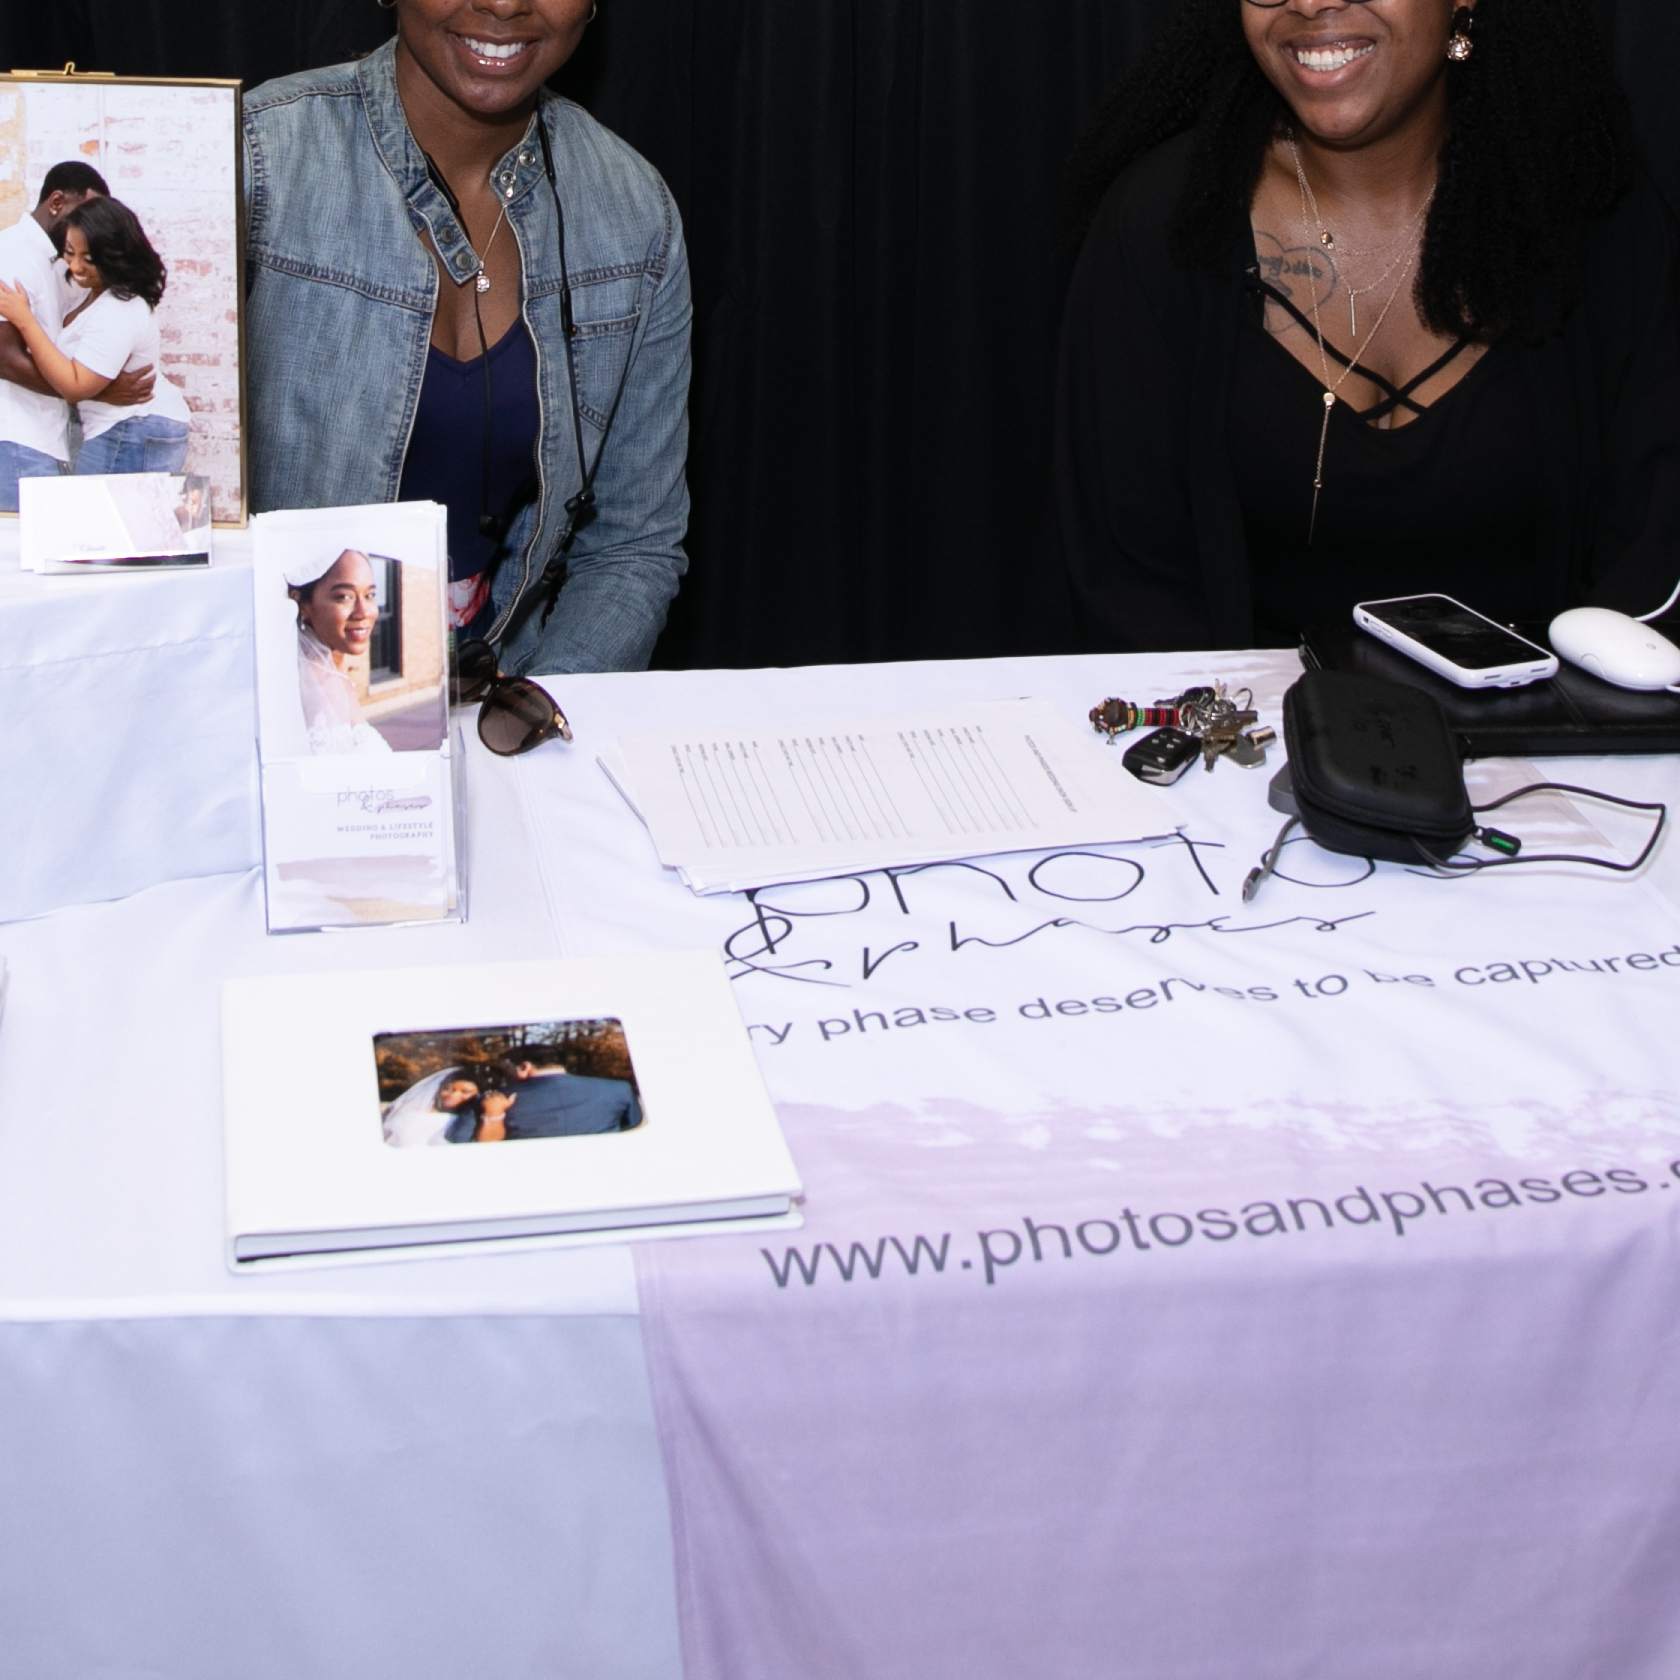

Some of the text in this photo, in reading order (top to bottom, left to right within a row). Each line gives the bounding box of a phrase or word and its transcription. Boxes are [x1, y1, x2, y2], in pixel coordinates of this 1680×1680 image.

[337, 784, 394, 807] photos
[337, 824, 378, 833] WEDDING
[390, 821, 433, 831] LIFESTYLE
[370, 830, 434, 840] PHOTOGRAPHY
[862, 911, 1376, 980] phases
[817, 1006, 998, 1041] phase
[1293, 974, 1348, 999] to
[1364, 969, 1435, 988] be
